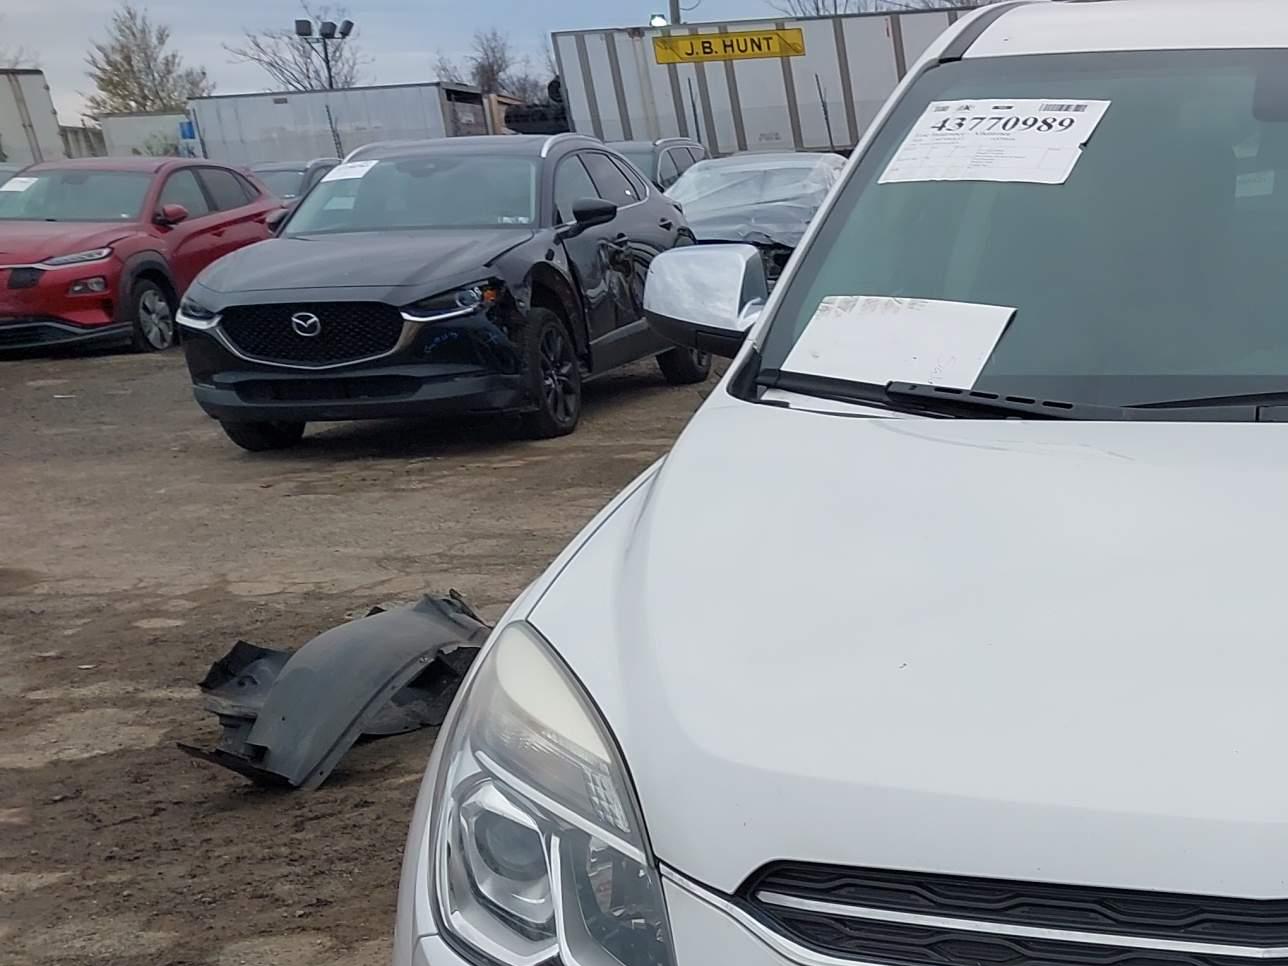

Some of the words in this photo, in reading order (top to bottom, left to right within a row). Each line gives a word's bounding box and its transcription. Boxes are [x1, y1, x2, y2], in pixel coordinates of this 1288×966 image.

[685, 41, 718, 56] J.B.
[722, 37, 773, 54] HUNT
[930, 116, 1076, 133] 43770989
